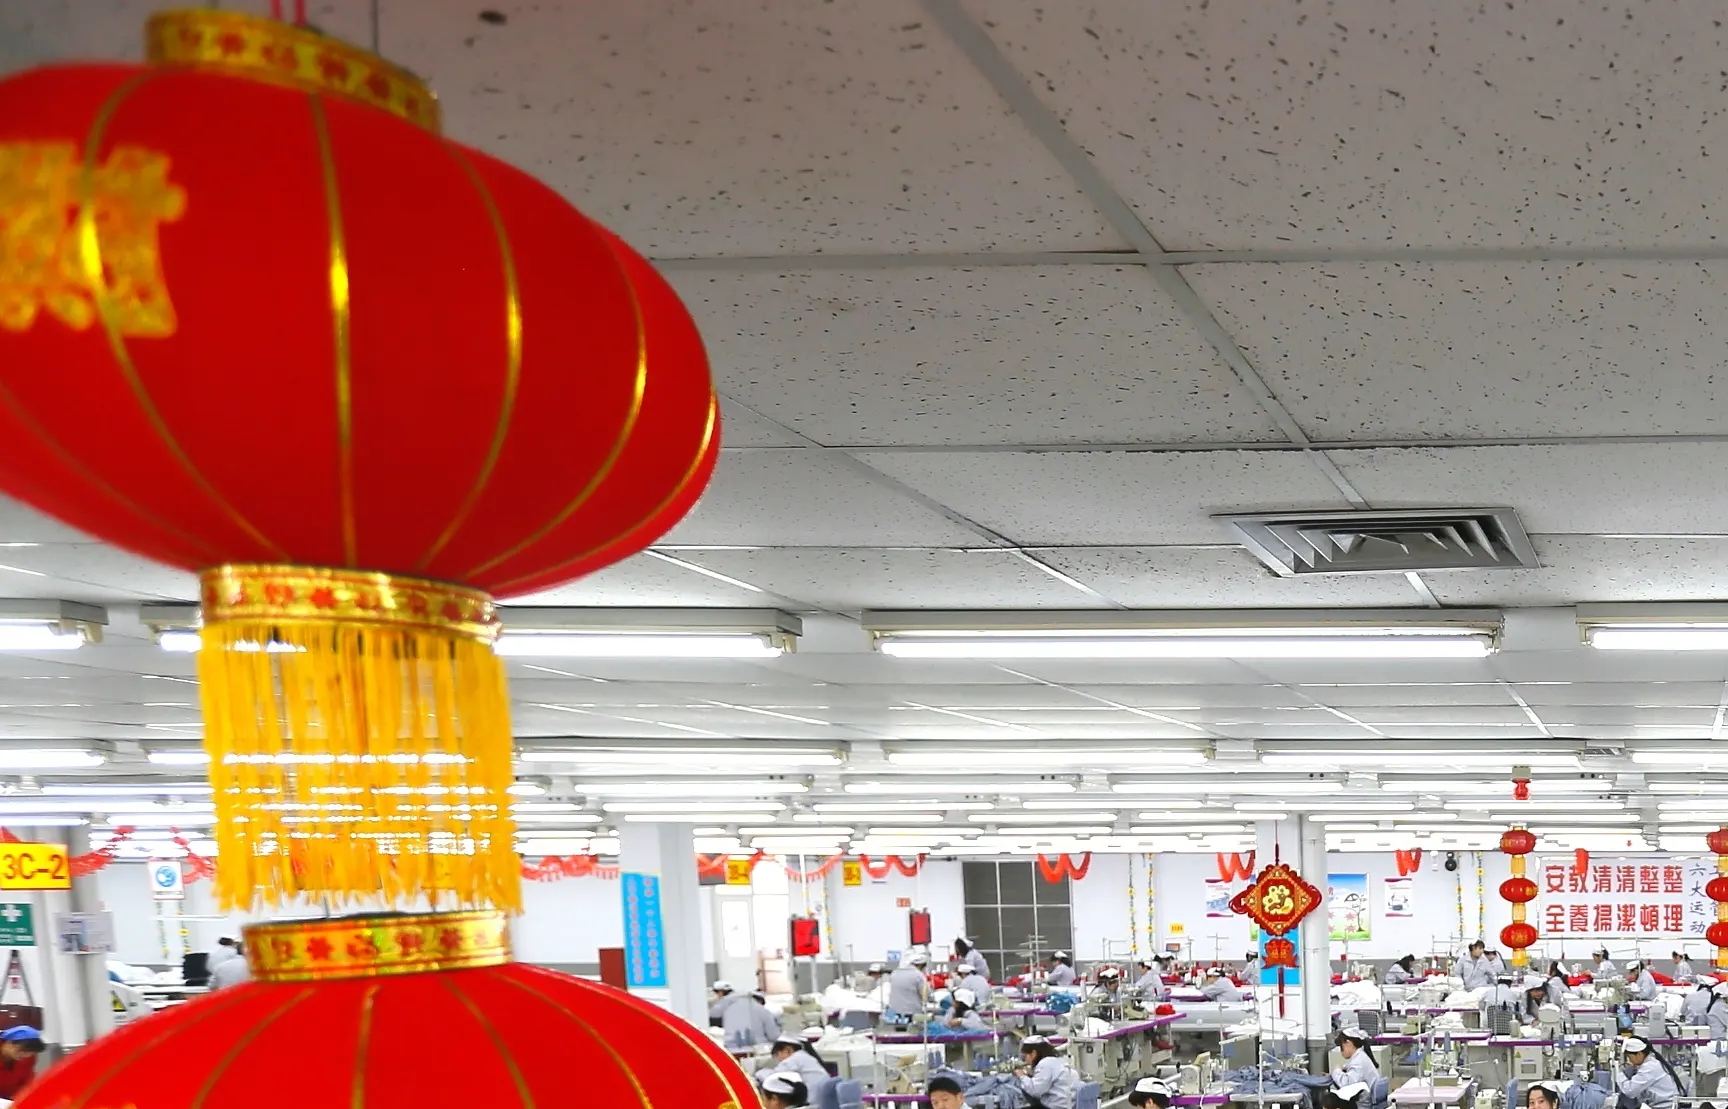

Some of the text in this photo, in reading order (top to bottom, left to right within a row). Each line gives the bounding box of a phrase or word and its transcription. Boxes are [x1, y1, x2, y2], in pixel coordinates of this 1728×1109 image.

[3, 852, 66, 880] 3C-2
[1688, 862, 1707, 934] 六大运动
